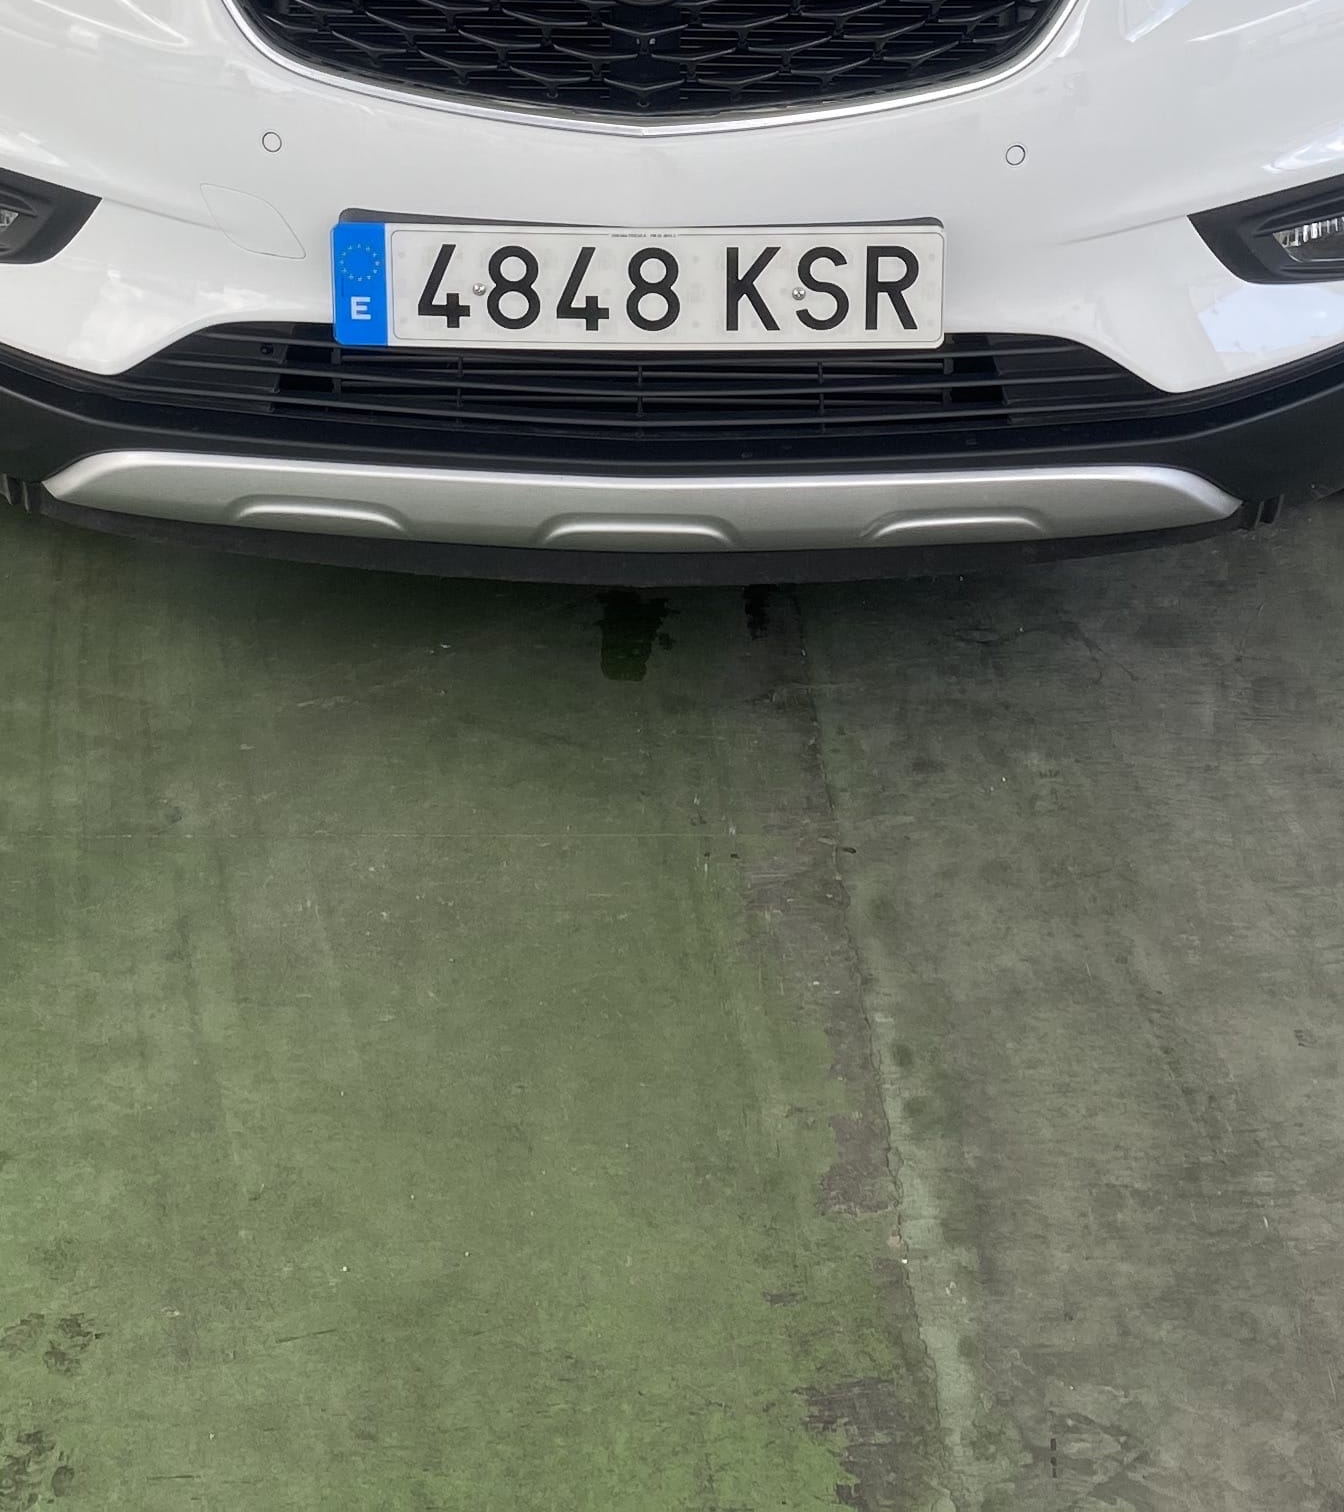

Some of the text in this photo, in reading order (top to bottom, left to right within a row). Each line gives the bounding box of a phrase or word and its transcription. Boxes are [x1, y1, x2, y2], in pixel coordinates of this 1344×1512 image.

[351, 296, 372, 320] E
[417, 243, 919, 333] 4848 KSR
